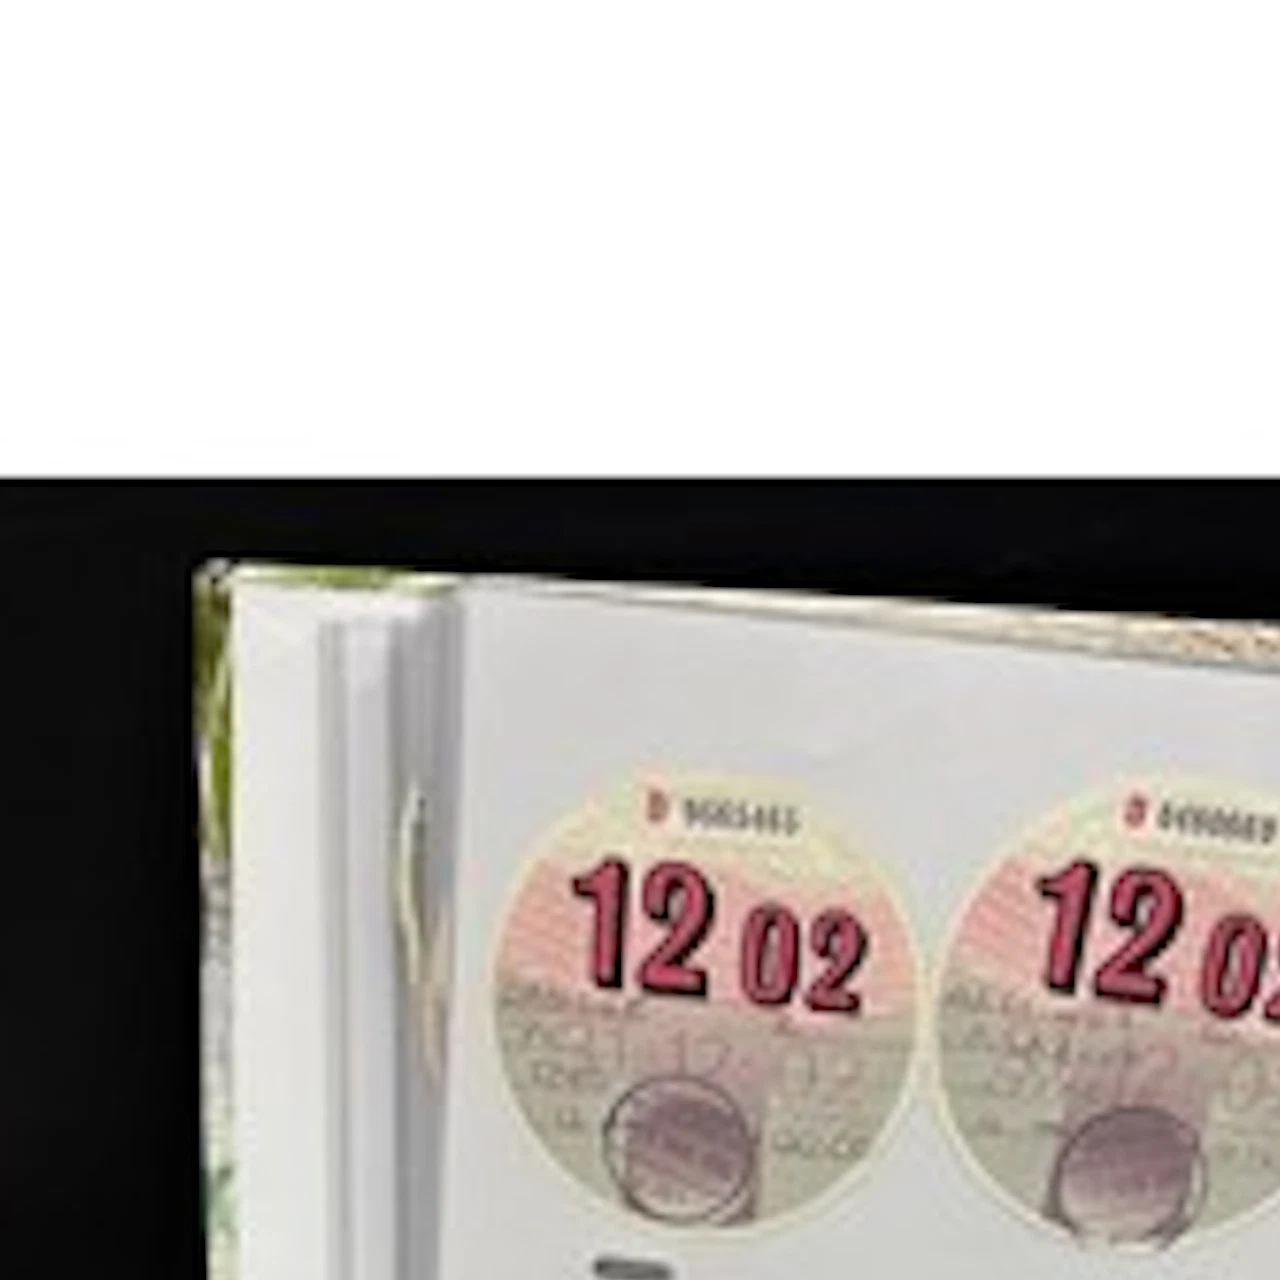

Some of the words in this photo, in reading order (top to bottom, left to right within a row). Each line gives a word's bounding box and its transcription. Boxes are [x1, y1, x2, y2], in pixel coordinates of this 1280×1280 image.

[571, 856, 716, 997] 12
[739, 902, 869, 1016] 02
[1037, 859, 1183, 1007] 12
